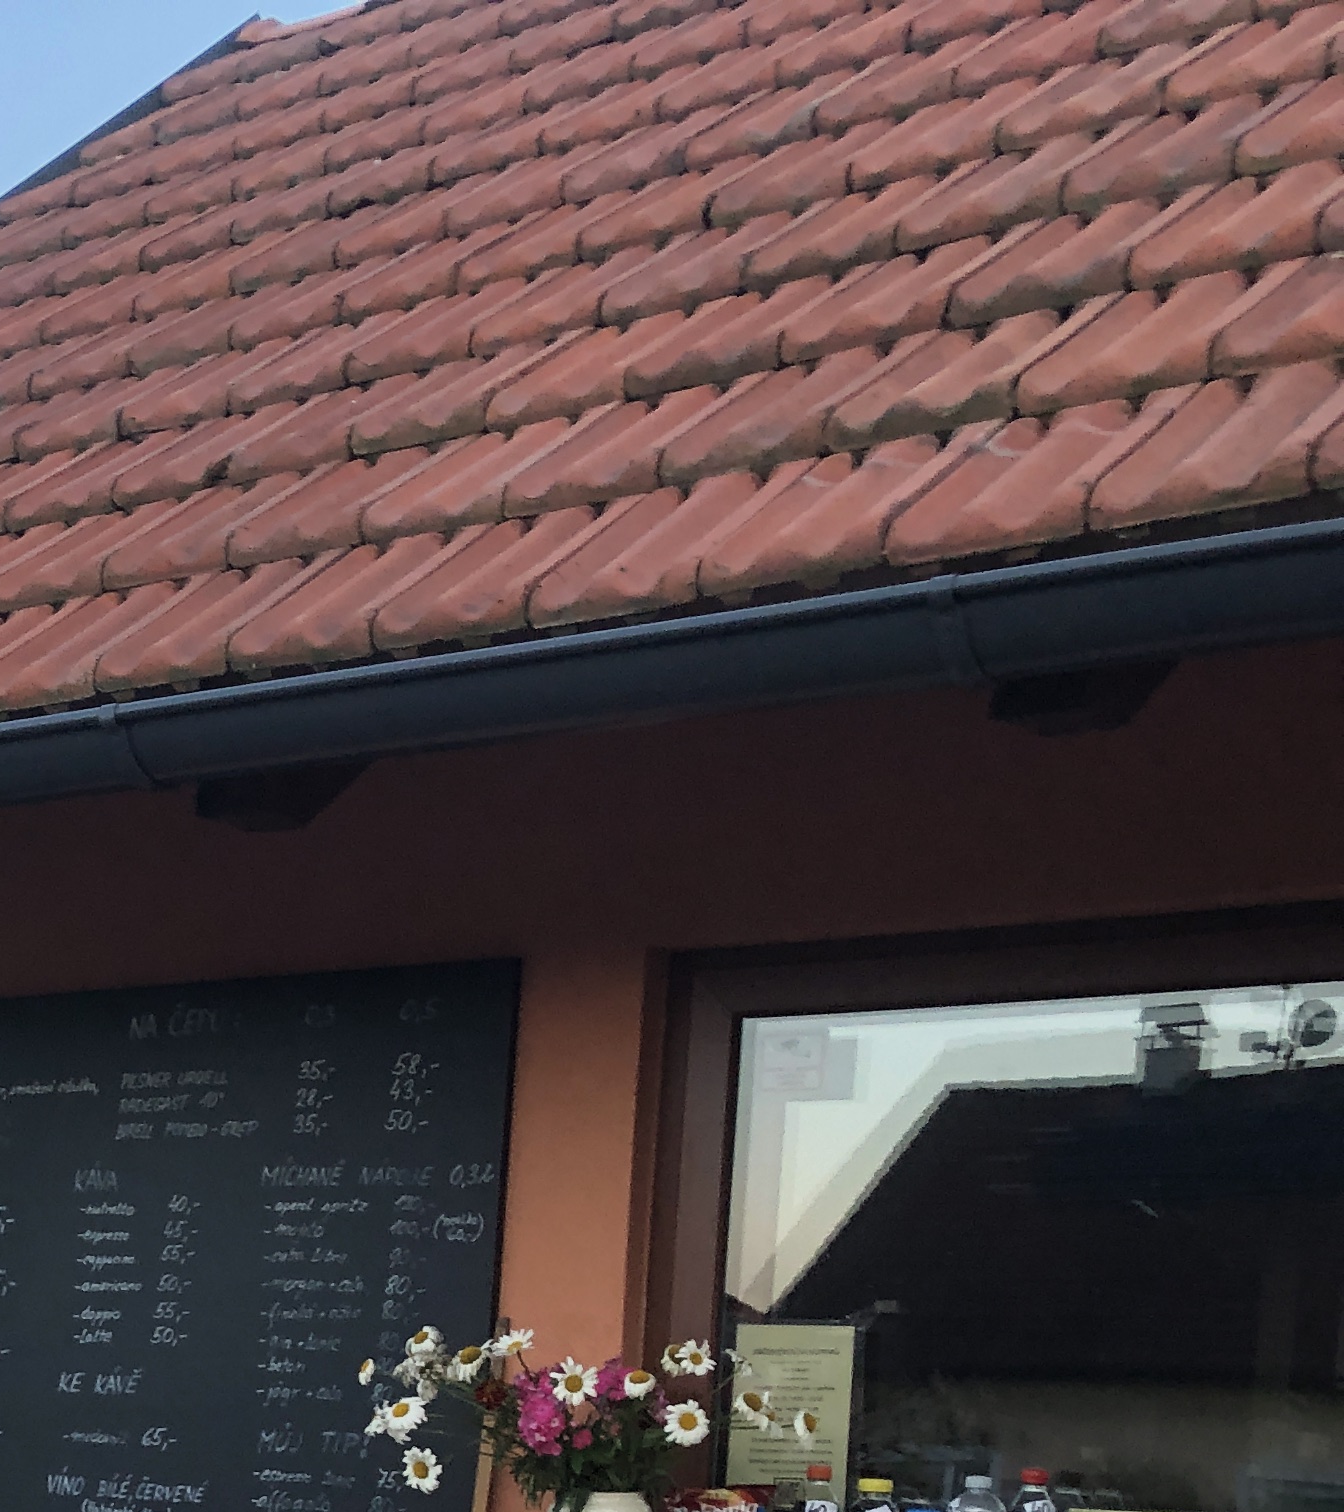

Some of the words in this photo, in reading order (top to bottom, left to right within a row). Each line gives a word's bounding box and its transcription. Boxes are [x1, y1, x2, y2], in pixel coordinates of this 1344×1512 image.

[58, 1370, 87, 1394] KE
[141, 1427, 178, 1452] 65,-
[47, 1466, 86, 1497] VÍNO
